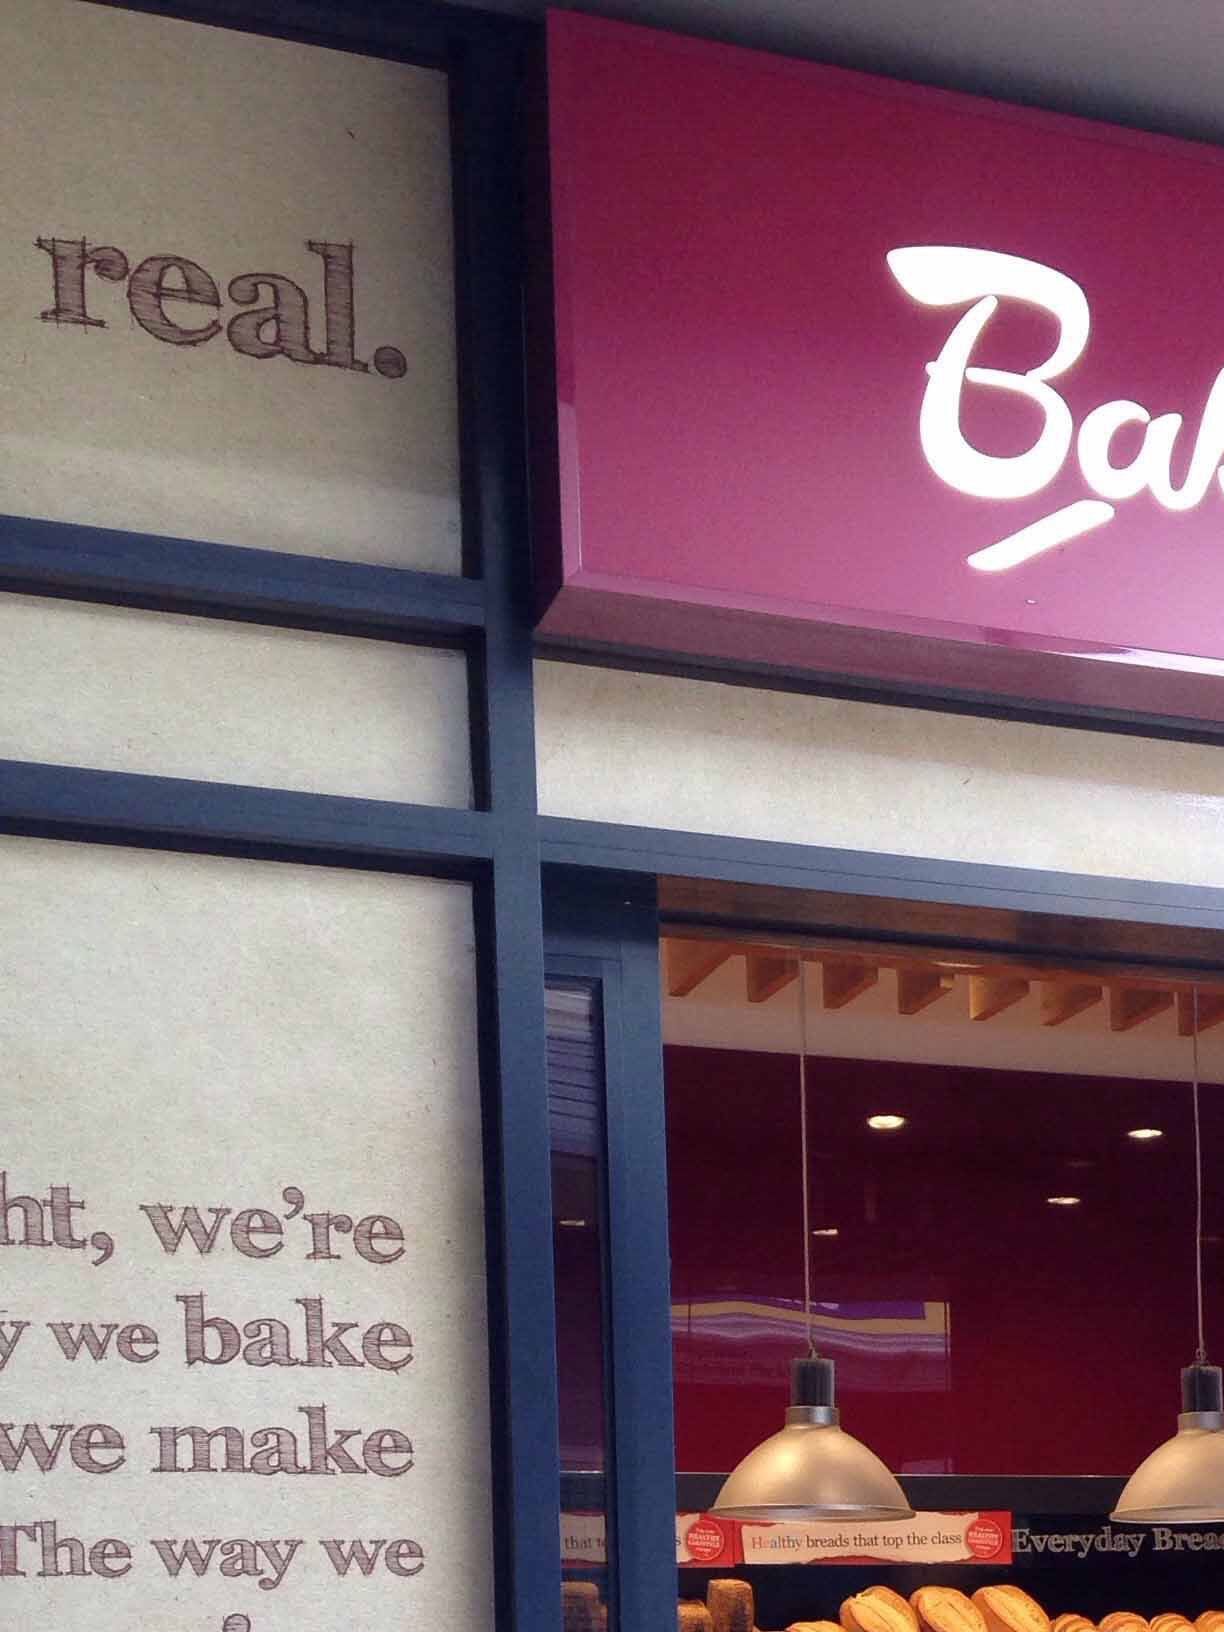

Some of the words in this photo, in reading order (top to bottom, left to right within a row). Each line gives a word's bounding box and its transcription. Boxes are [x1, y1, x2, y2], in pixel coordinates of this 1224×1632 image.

[33, 236, 407, 378] real.
[139, 1186, 407, 1265] we're
[47, 1320, 160, 1363] we
[176, 1292, 415, 1373] bake
[0, 1422, 127, 1474] we
[150, 1404, 415, 1478] make
[151, 1534, 303, 1589] way
[320, 1536, 425, 1578] we
[751, 1536, 801, 1552] Healthy
[805, 1534, 851, 1549] breads
[853, 1533, 880, 1548] that
[881, 1535, 904, 1550] top
[906, 1532, 929, 1547] the
[931, 1531, 962, 1546] class
[1011, 1527, 1146, 1559] Everyday
